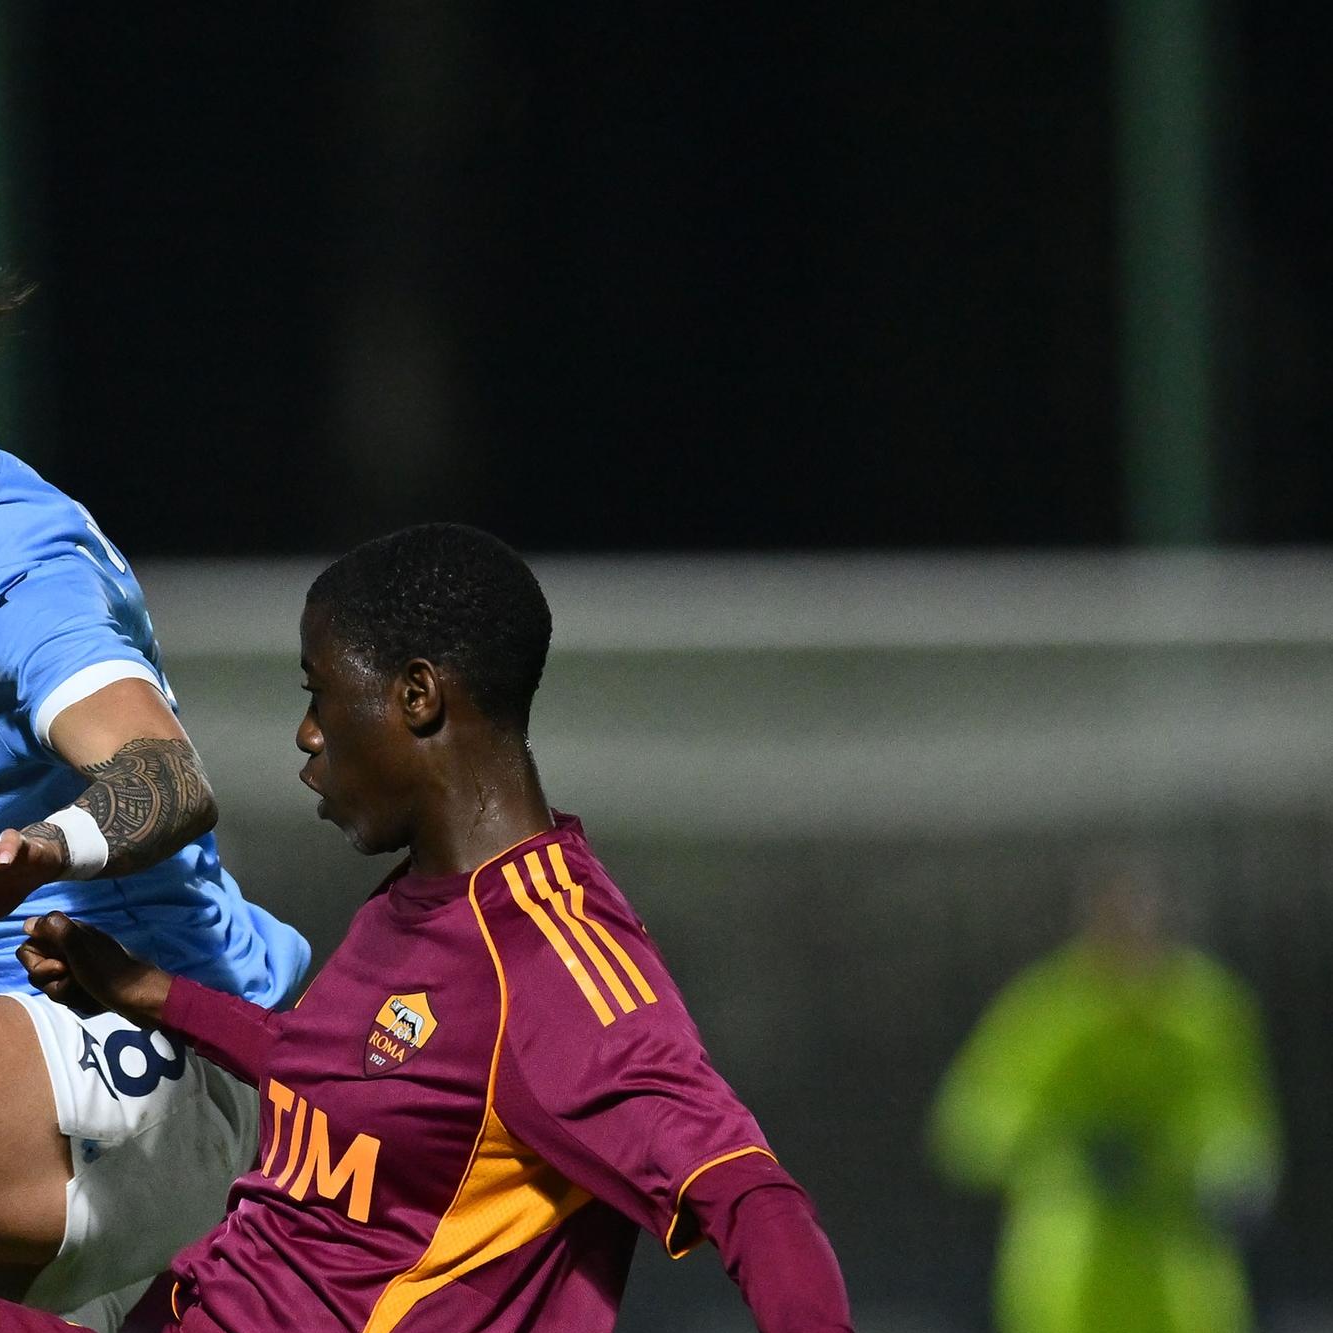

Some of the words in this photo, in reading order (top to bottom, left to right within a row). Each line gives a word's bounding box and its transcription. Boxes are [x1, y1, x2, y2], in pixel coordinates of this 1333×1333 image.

[71, 1008, 186, 1097] 8
[368, 1030, 406, 1063] ROMA
[369, 1052, 386, 1067] 1927
[261, 1078, 381, 1224] TIM
